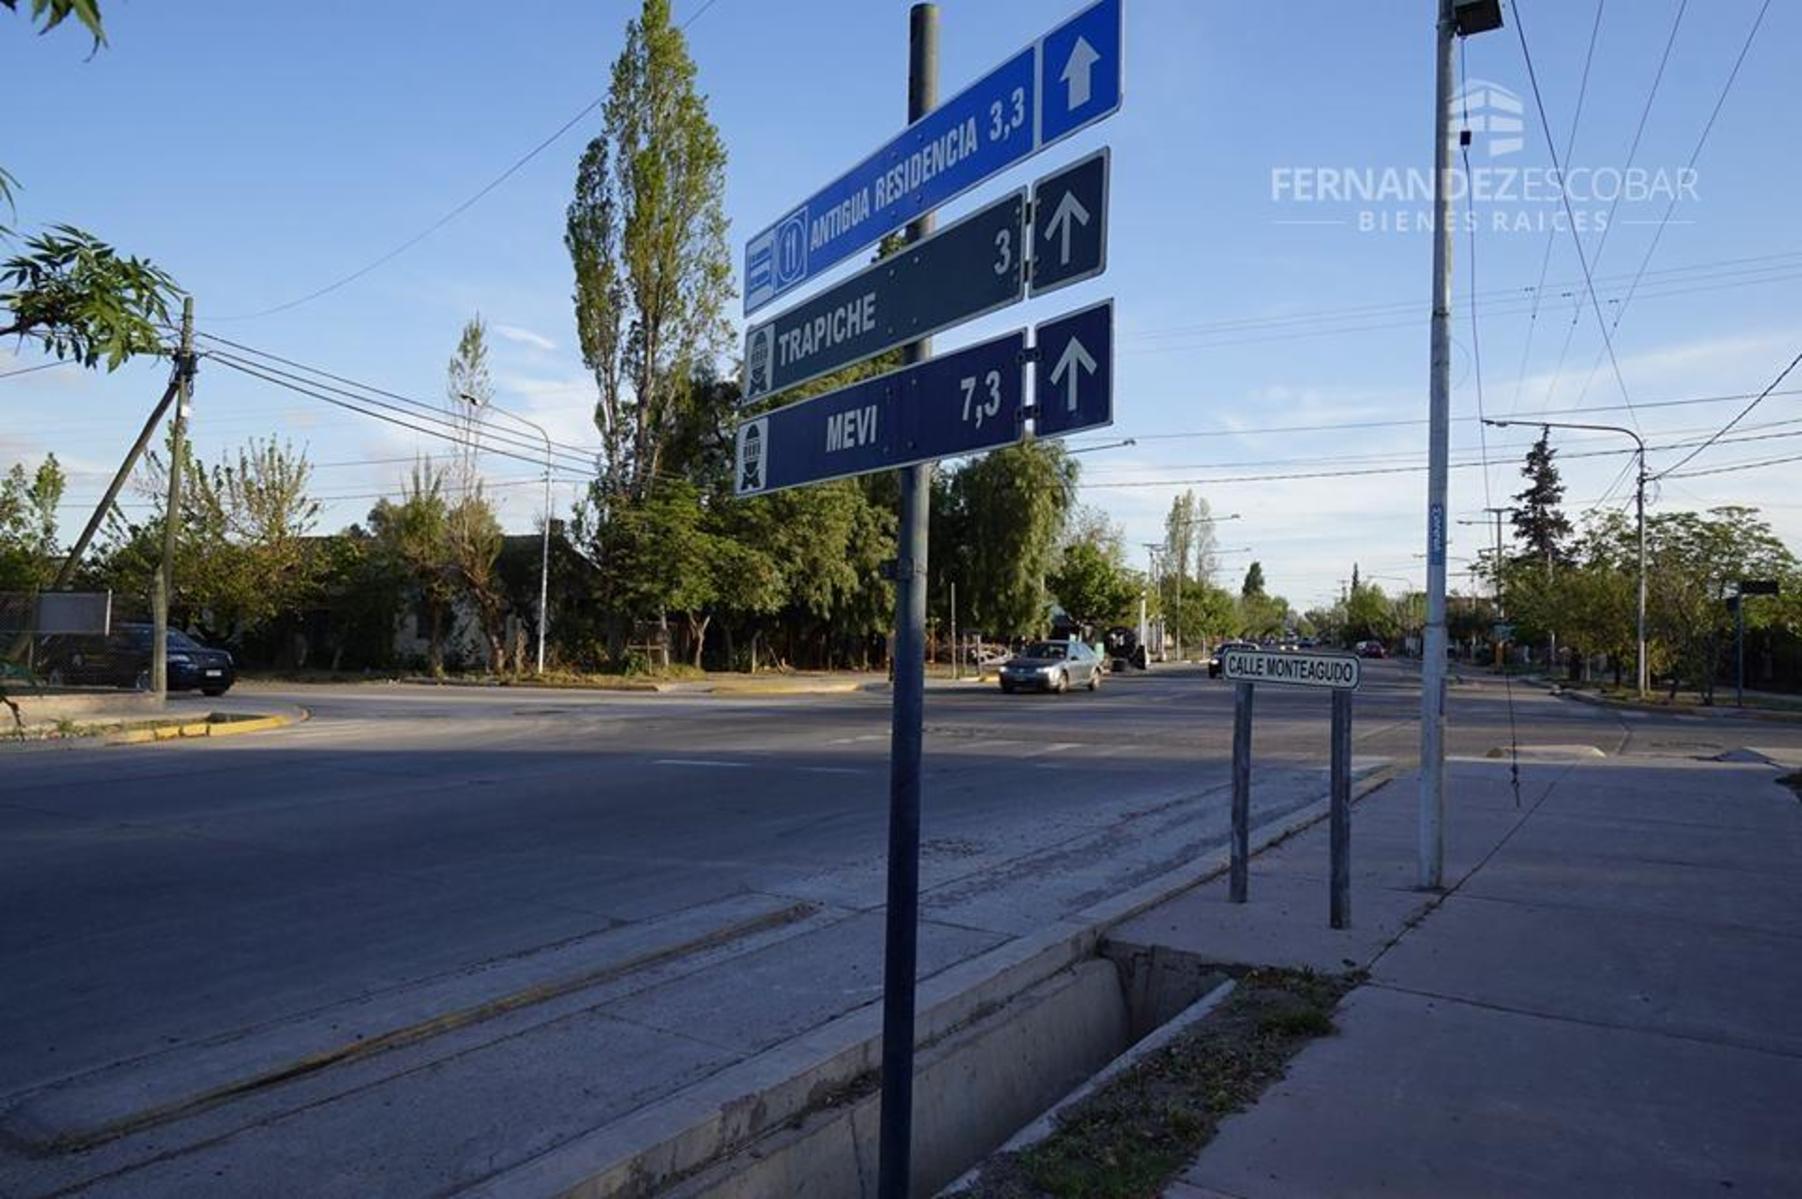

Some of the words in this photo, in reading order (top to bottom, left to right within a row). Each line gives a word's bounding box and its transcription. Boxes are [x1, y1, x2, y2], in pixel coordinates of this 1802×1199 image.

[811, 187, 870, 251] ANTIGUA
[875, 117, 978, 212] RESIDENCIA
[989, 87, 1025, 141] 3,3
[778, 292, 876, 366] TRAPICHE
[994, 229, 1011, 275] 3
[826, 405, 878, 453] MEVI
[960, 370, 1001, 428] 7,3
[1228, 655, 1264, 676] CALLE
[1266, 658, 1353, 682] MONTEAGUDO
